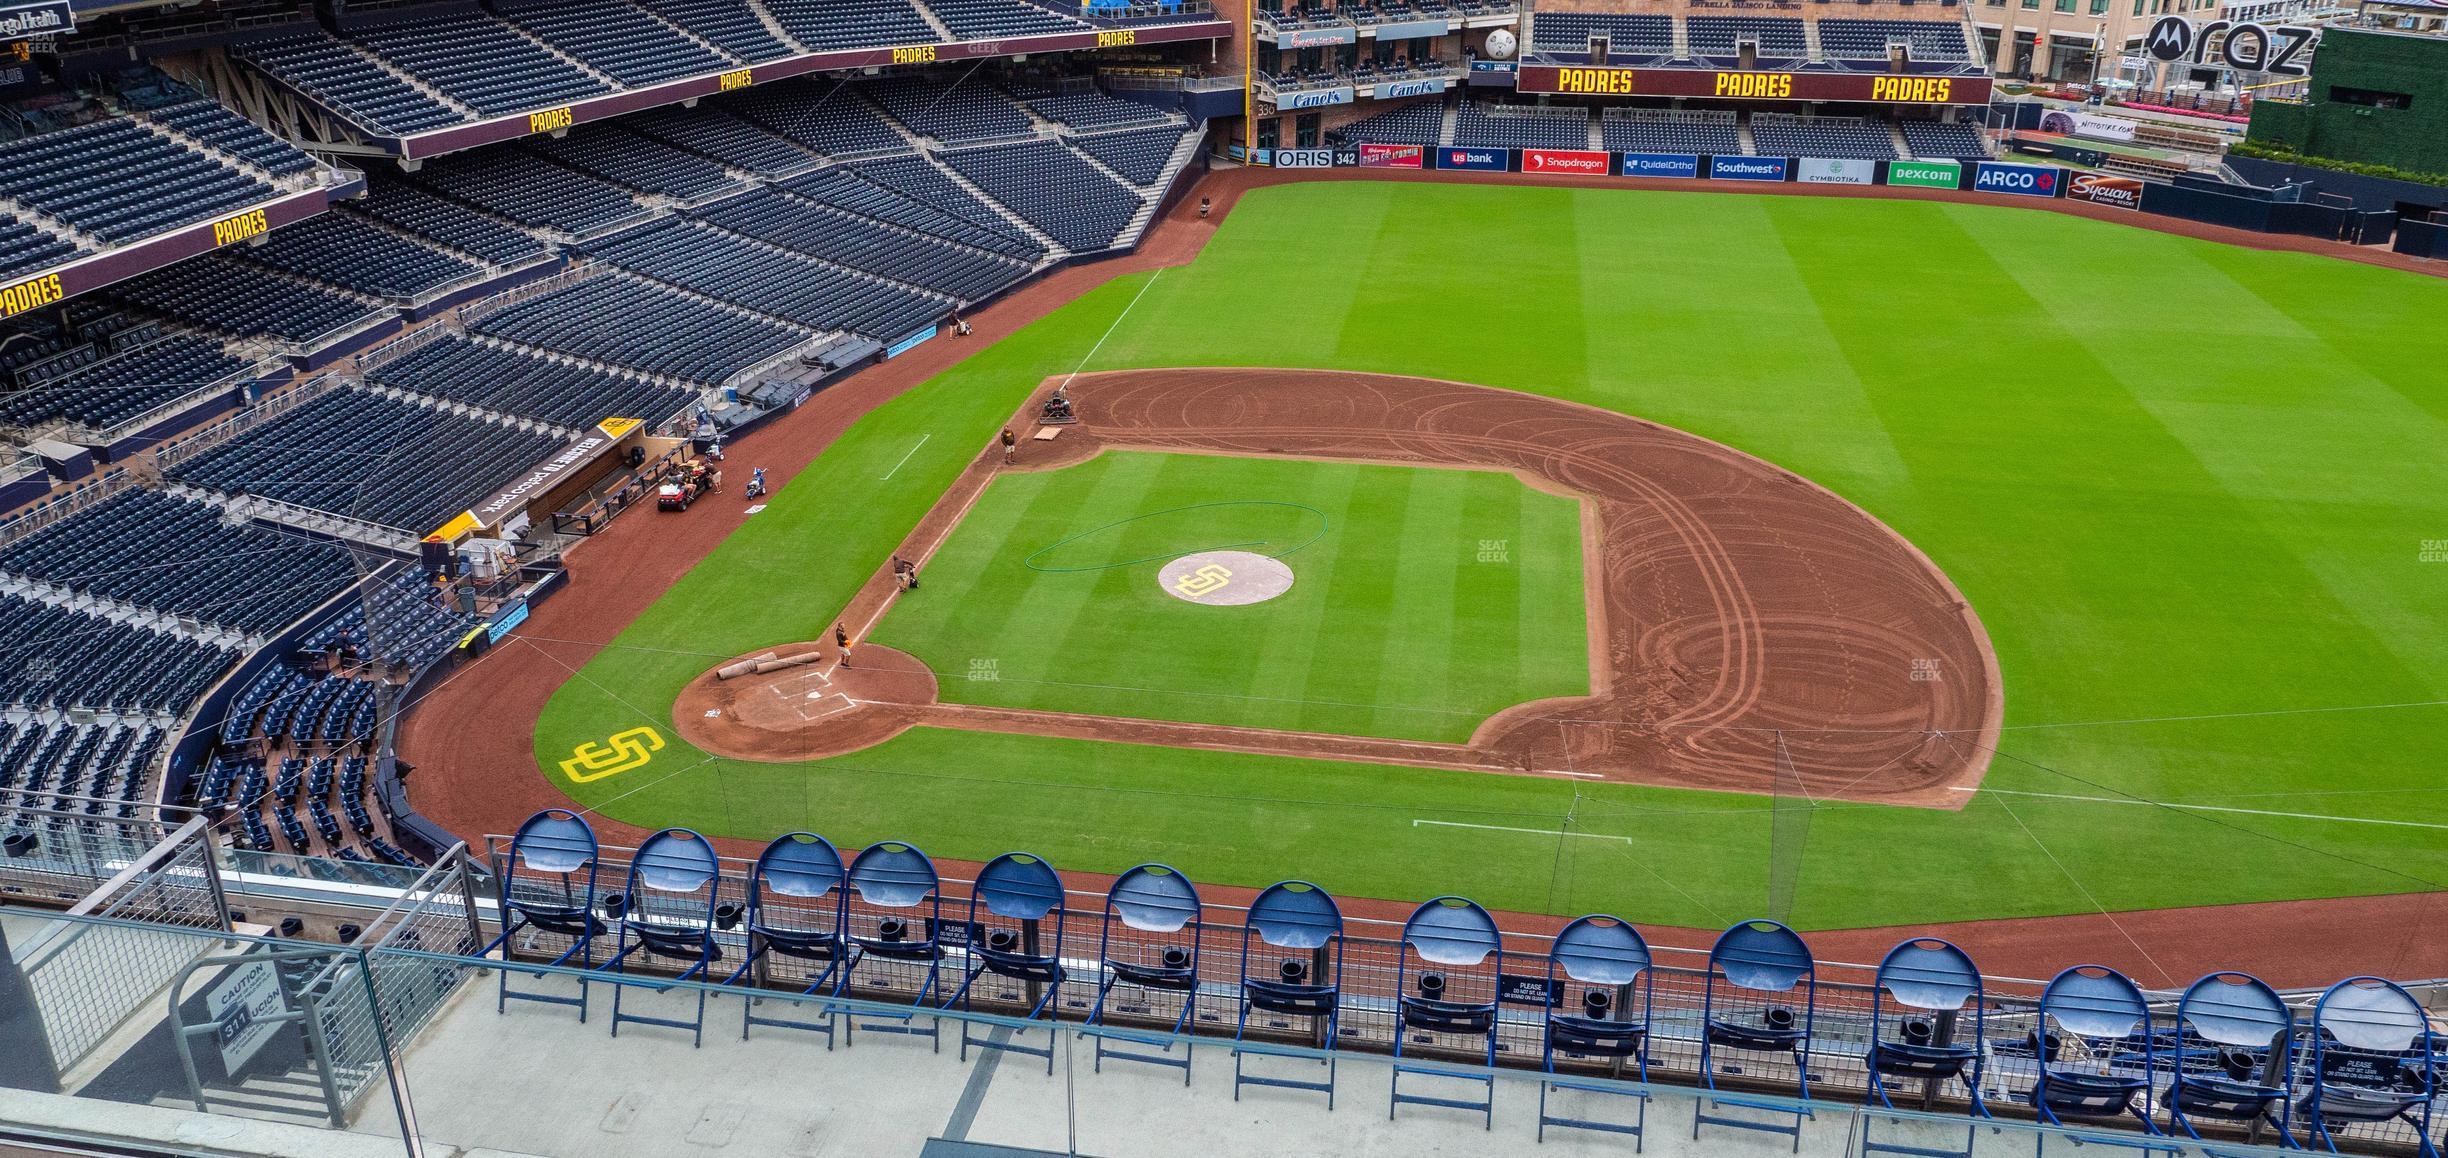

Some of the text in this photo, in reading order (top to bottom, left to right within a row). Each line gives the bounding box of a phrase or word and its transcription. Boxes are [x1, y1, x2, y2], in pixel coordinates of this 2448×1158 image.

[1098, 31, 1136, 47] PADRES
[2194, 20, 2321, 76] raz
[893, 46, 936, 64] PADRES
[720, 69, 752, 91] PADRES
[1388, 81, 1433, 97] Canel's
[1558, 68, 1633, 93] PADRES
[1714, 73, 1792, 97] PADRES
[2066, 82, 2086, 90] petco
[1871, 77, 1951, 102] PADRES
[1292, 91, 1340, 109] Canel's
[1257, 104, 1275, 117] 336
[529, 108, 573, 133] PADRES
[1278, 151, 1331, 166] ORIS
[1336, 152, 1356, 165] 342
[1547, 157, 1603, 169] Snapdragon
[1640, 160, 1693, 170] QuidelOrtho
[1716, 162, 1774, 174] Southwest
[1809, 175, 1860, 183] CYMBIOTIKA
[1978, 170, 2034, 188] ARCO
[2072, 175, 2134, 200] Sycuan
[213, 209, 267, 247] PADRES
[481, 437, 604, 513] WELCOME TO petco park
[489, 621, 509, 641] petco
[945, 925, 965, 933] PLEASE
[221, 963, 264, 1005] CAUTION
[1520, 982, 1542, 990] PLEASE
[224, 1012, 247, 1039] 311
[2347, 1060, 2373, 1068] PLEASE
